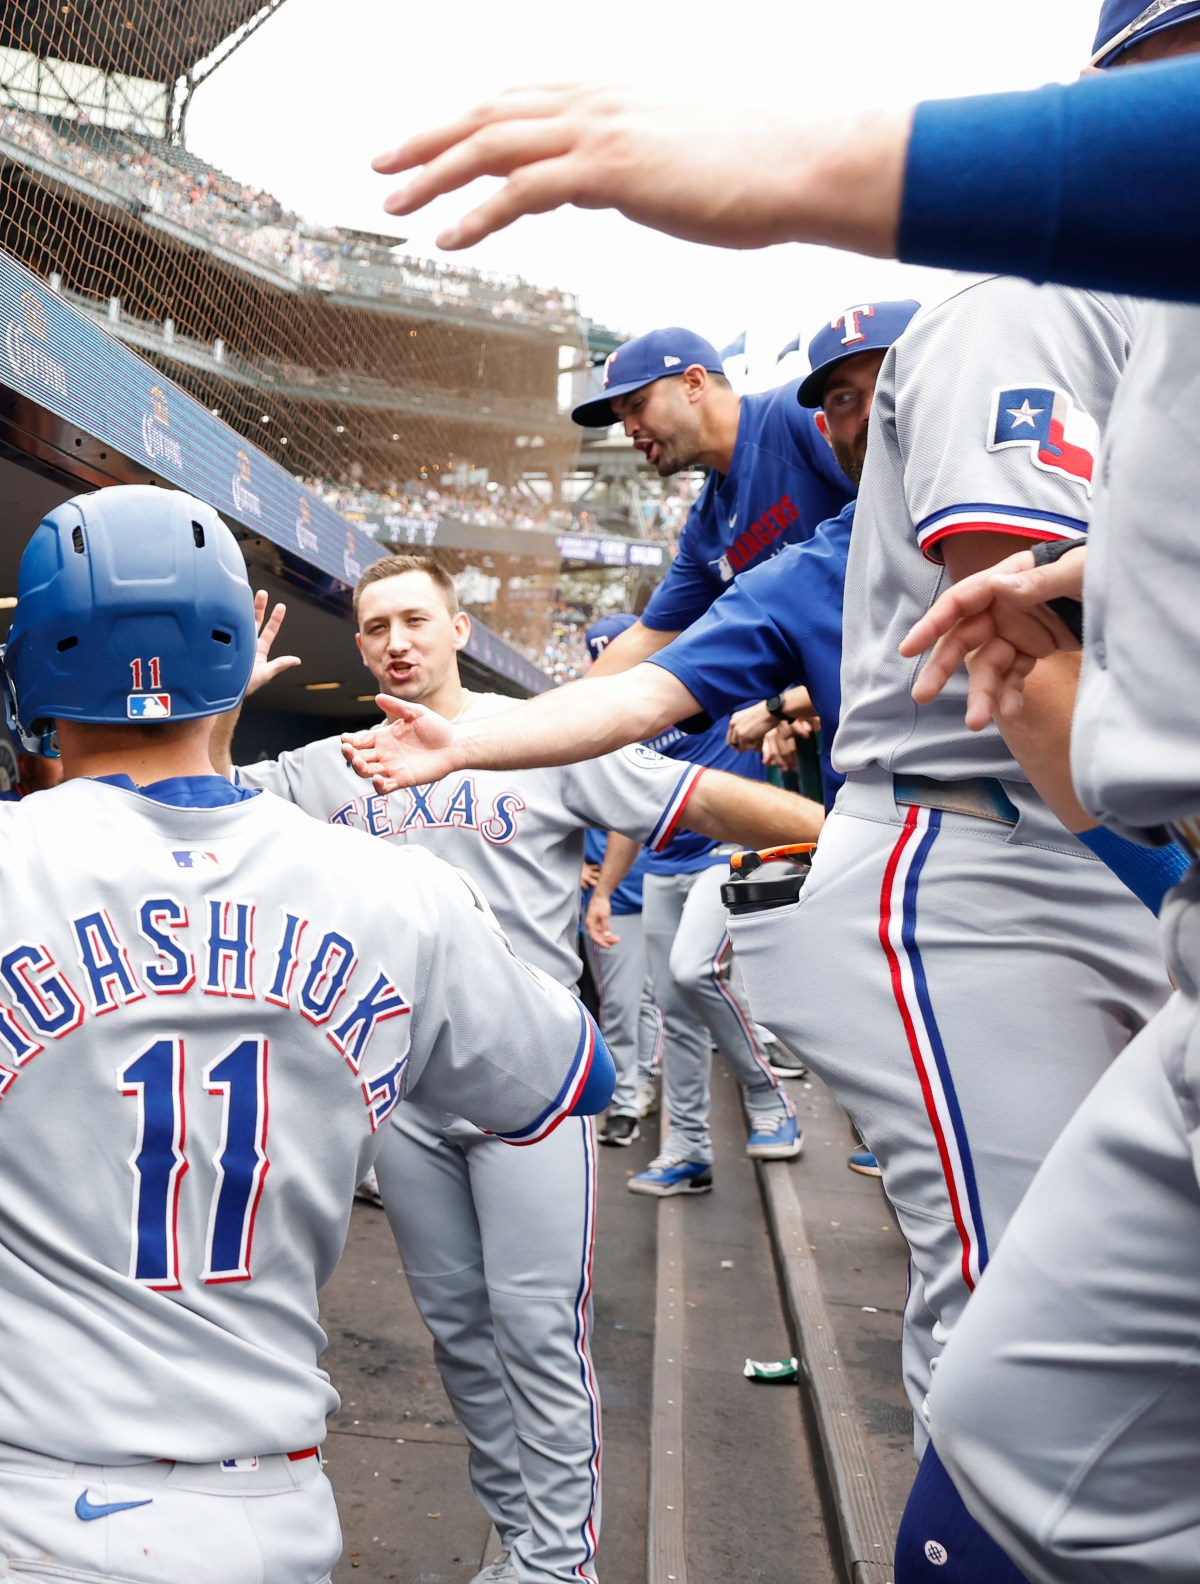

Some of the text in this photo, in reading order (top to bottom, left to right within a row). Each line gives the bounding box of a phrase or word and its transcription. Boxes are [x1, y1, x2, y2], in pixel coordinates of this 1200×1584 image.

[830, 304, 875, 347] T
[726, 494, 799, 571] RANGERS
[129, 656, 162, 690] 11
[328, 776, 526, 845] TEXAS
[116, 1033, 270, 1291] 11
